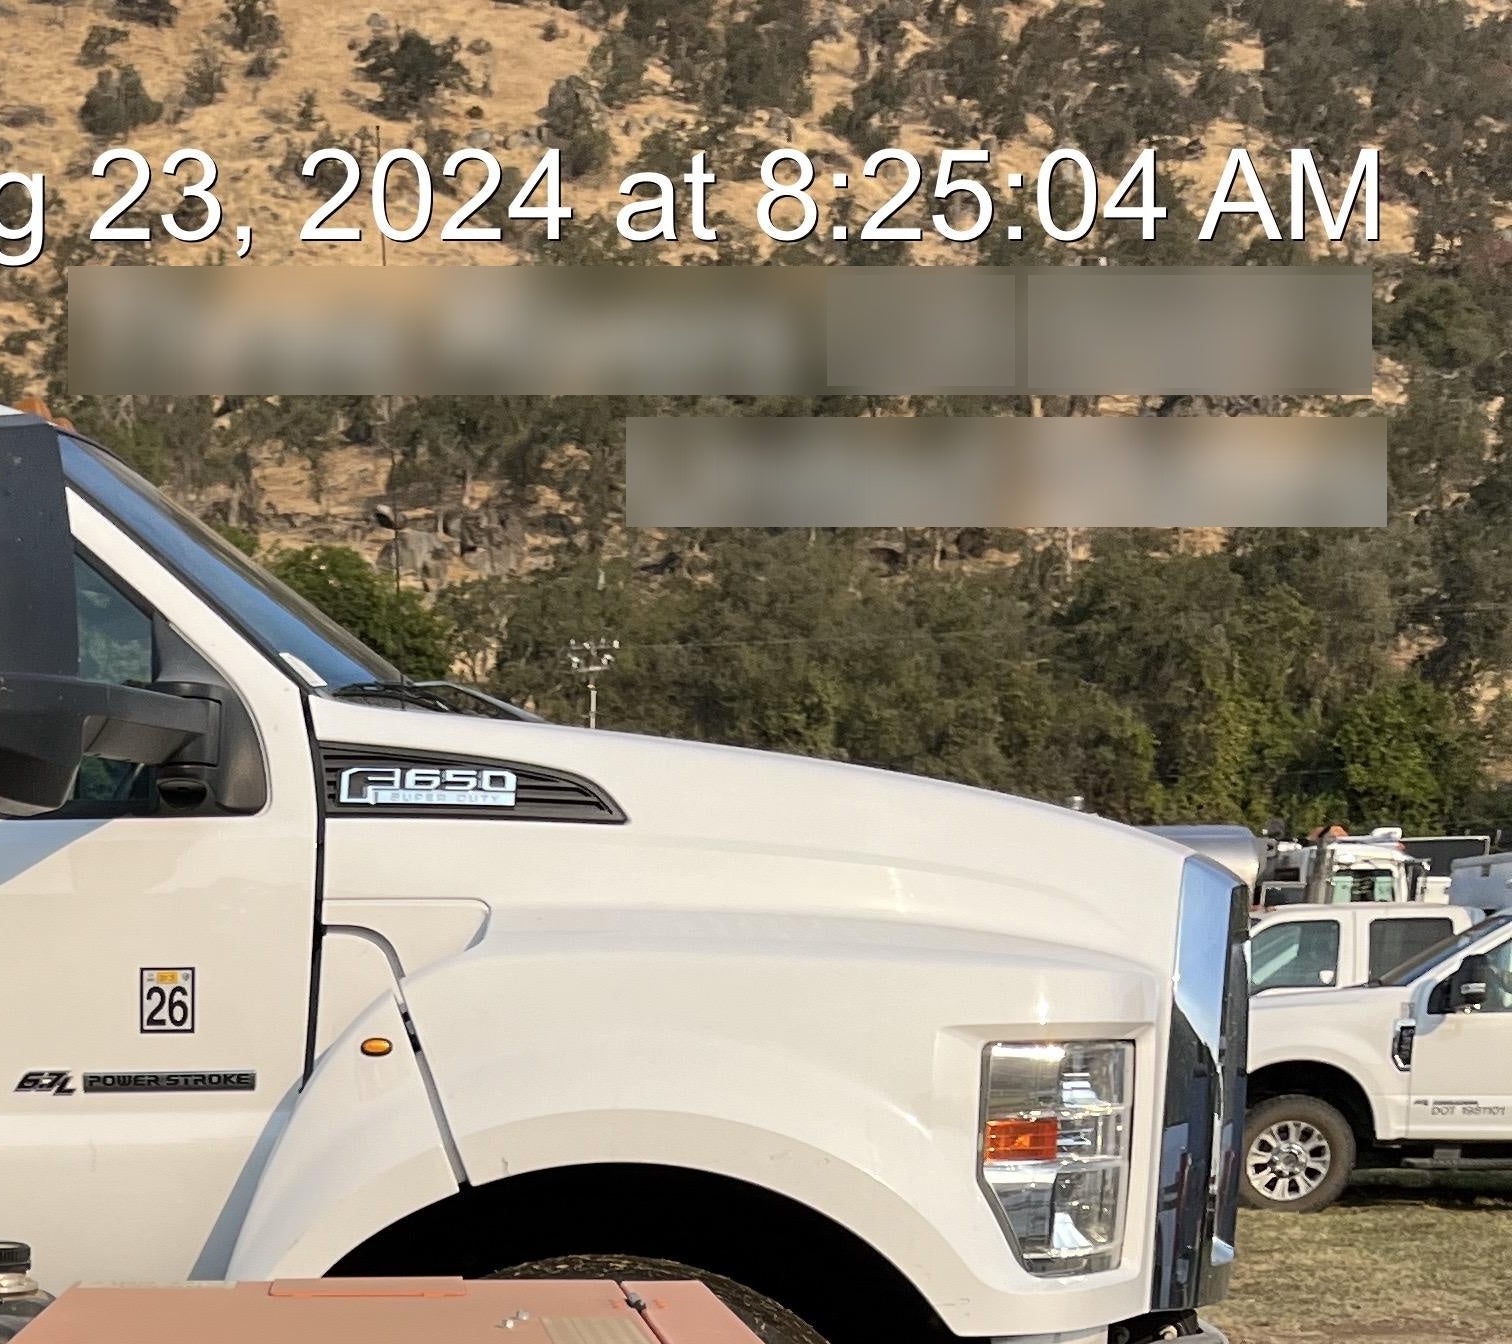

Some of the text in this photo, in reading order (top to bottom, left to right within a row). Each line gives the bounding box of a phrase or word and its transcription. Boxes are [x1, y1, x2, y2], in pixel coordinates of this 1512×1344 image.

[145, 985, 189, 1028] 26
[88, 1073, 251, 1087] POWER STROKE
